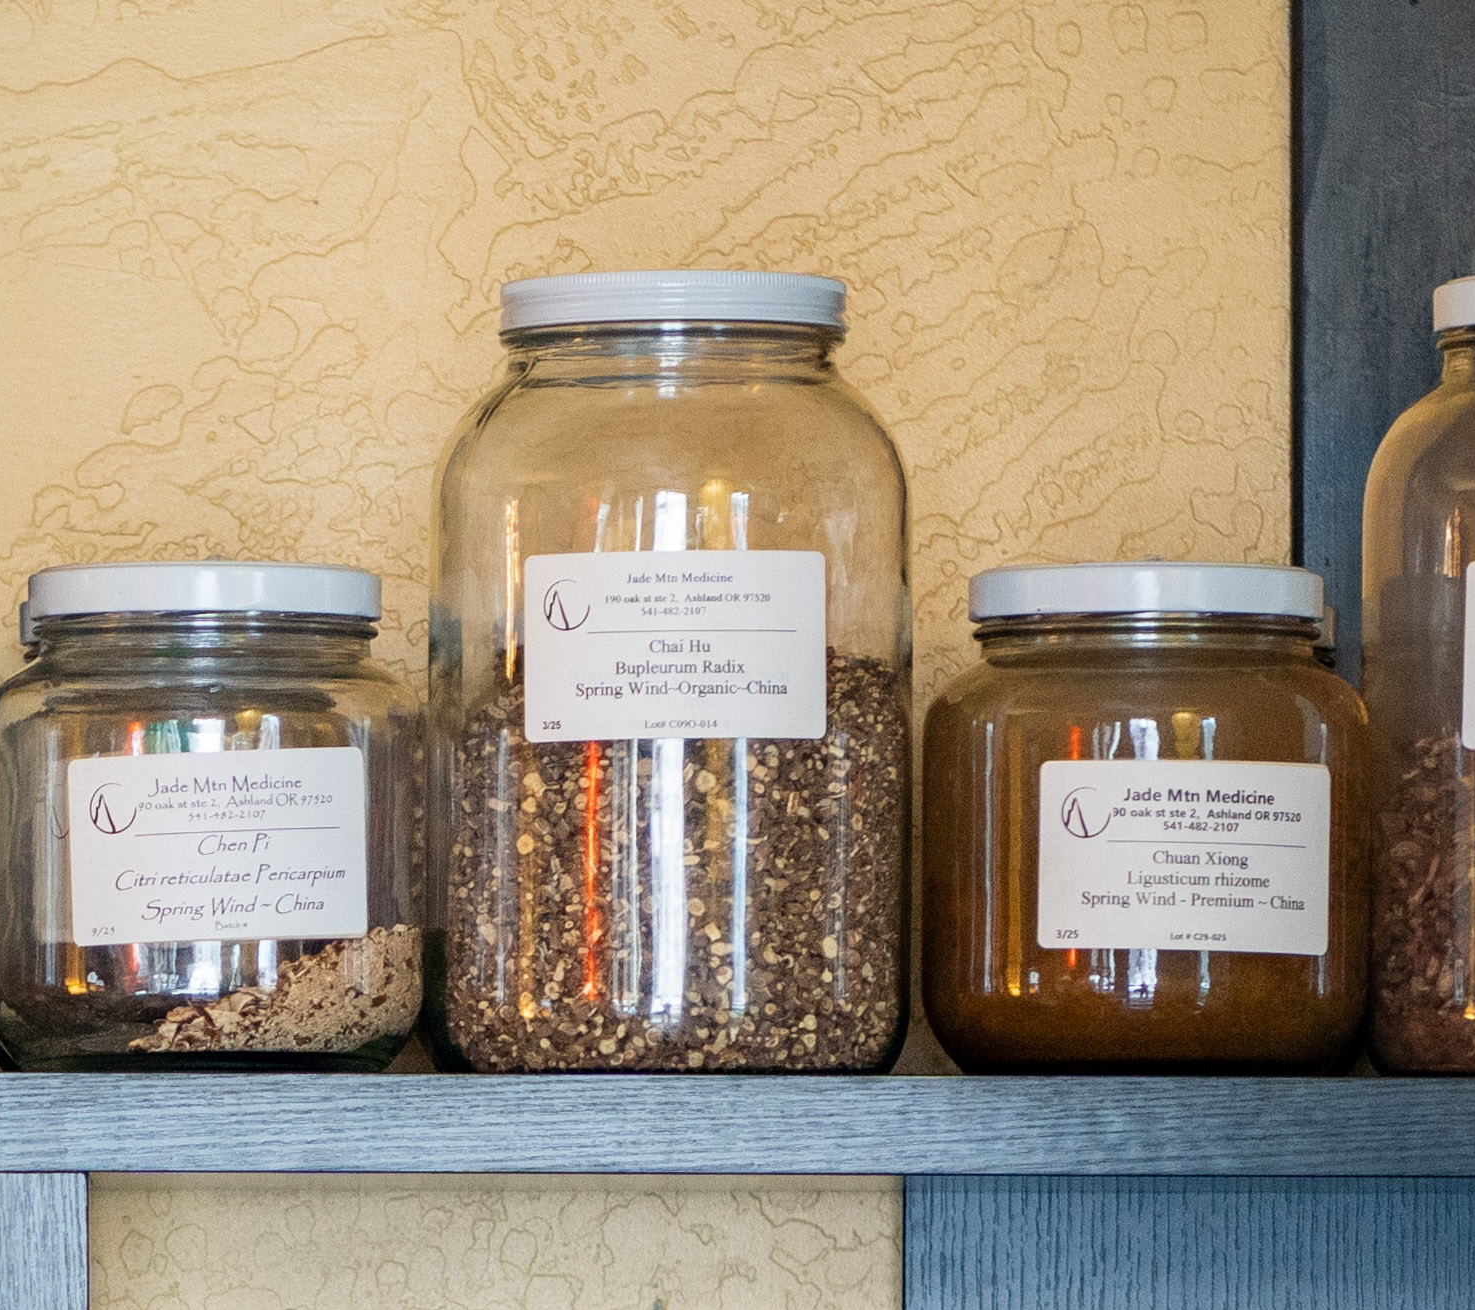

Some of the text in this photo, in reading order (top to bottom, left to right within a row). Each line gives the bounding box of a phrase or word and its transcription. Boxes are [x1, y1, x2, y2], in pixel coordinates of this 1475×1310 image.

[649, 639, 710, 653] Chai Hu
[616, 660, 744, 677] Bupleurum Radix
[196, 832, 269, 855] Chen Pi
[1153, 851, 1248, 869] Chuan Xiong
[1128, 871, 1270, 888] Ligusticum rhizome
